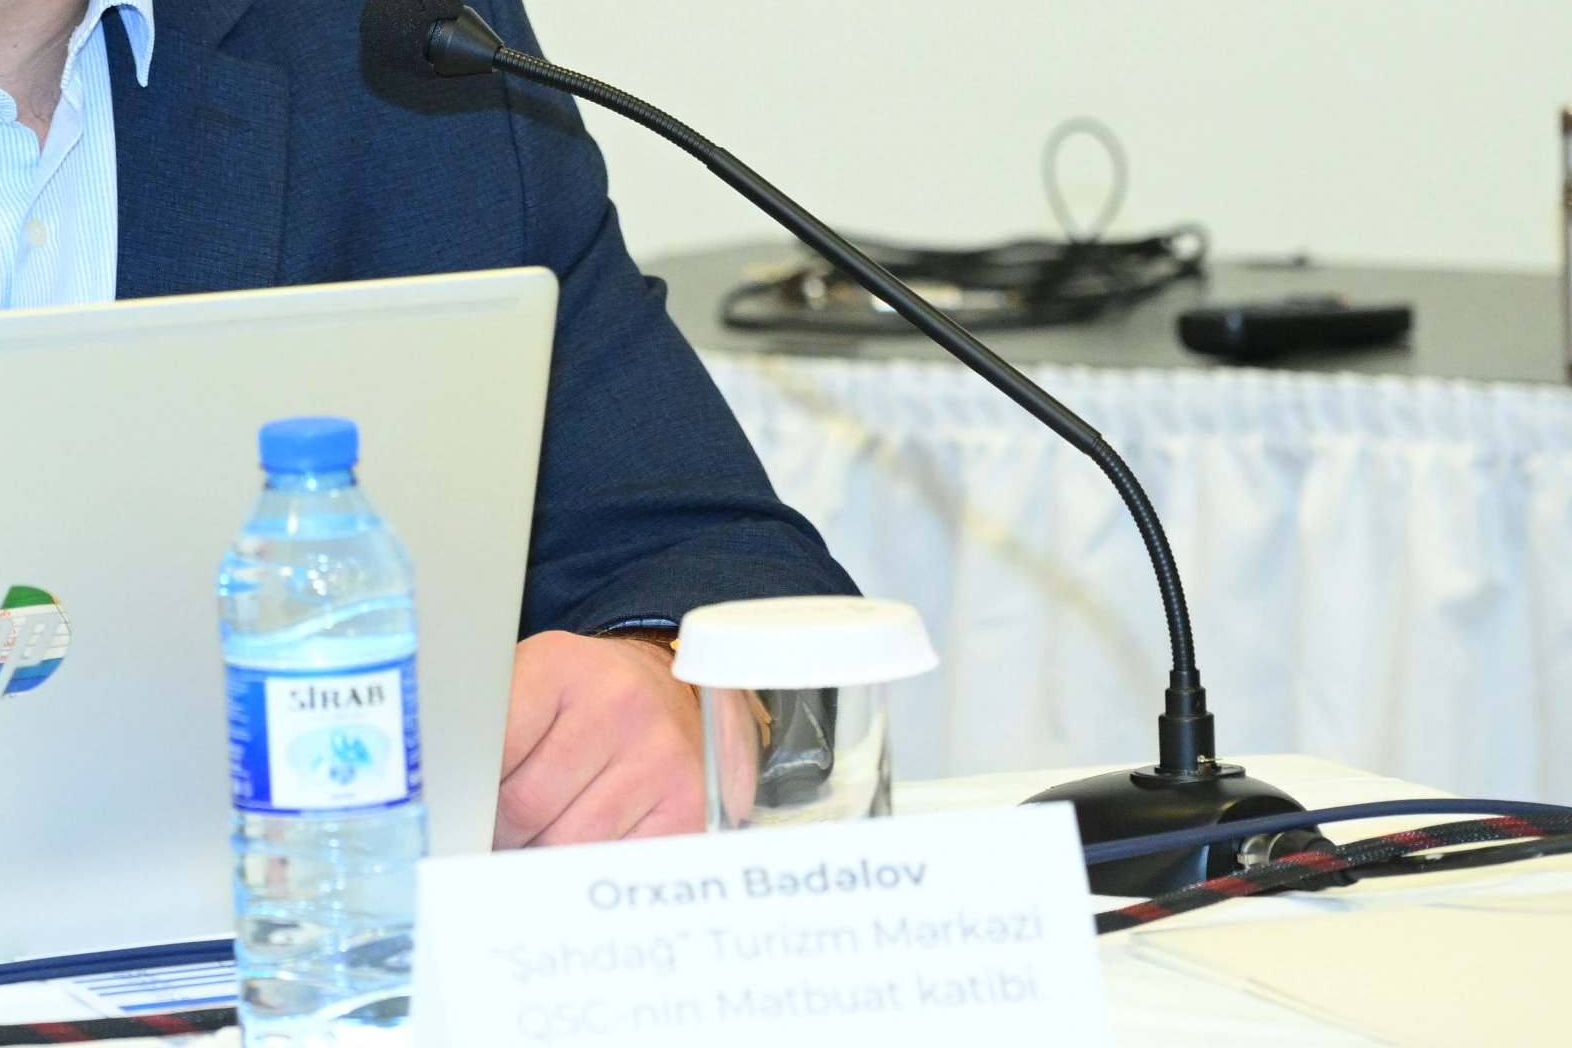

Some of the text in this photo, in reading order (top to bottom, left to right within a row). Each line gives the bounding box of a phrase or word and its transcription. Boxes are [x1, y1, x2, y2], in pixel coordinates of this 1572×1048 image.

[587, 856, 928, 912] Orxan Bədəlov
[708, 920, 859, 964] Turizm
[872, 905, 1046, 949] Mərkəzi
[718, 977, 904, 1025] Mətbuat
[916, 967, 1040, 1010] katibi
